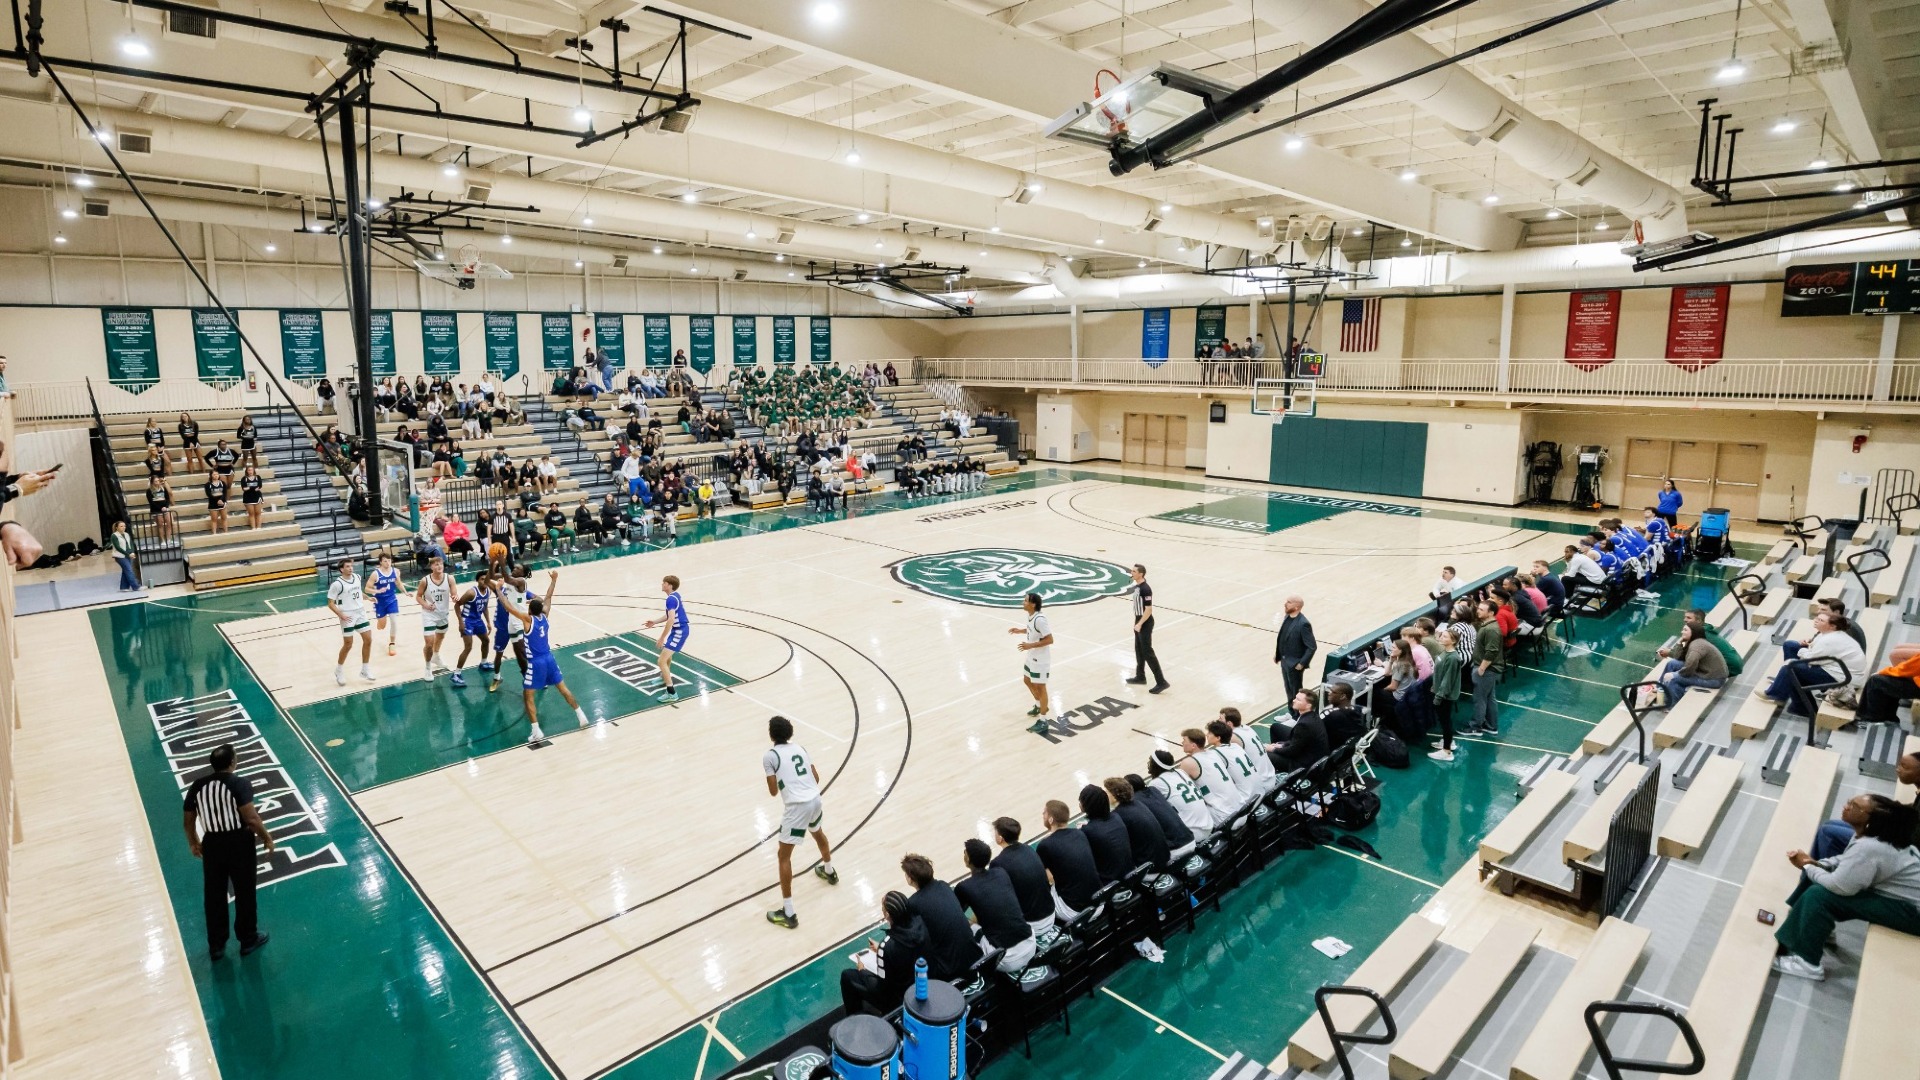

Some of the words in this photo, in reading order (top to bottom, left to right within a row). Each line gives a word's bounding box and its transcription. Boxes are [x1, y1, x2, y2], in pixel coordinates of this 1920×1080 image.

[1871, 264, 1897, 279] 44
[1880, 296, 1885, 307] 1
[352, 592, 360, 600] 30
[539, 626, 545, 637] 3
[1037, 696, 1140, 744] NCAA
[791, 754, 807, 776] 2
[950, 1026, 958, 1079] POWERADE
